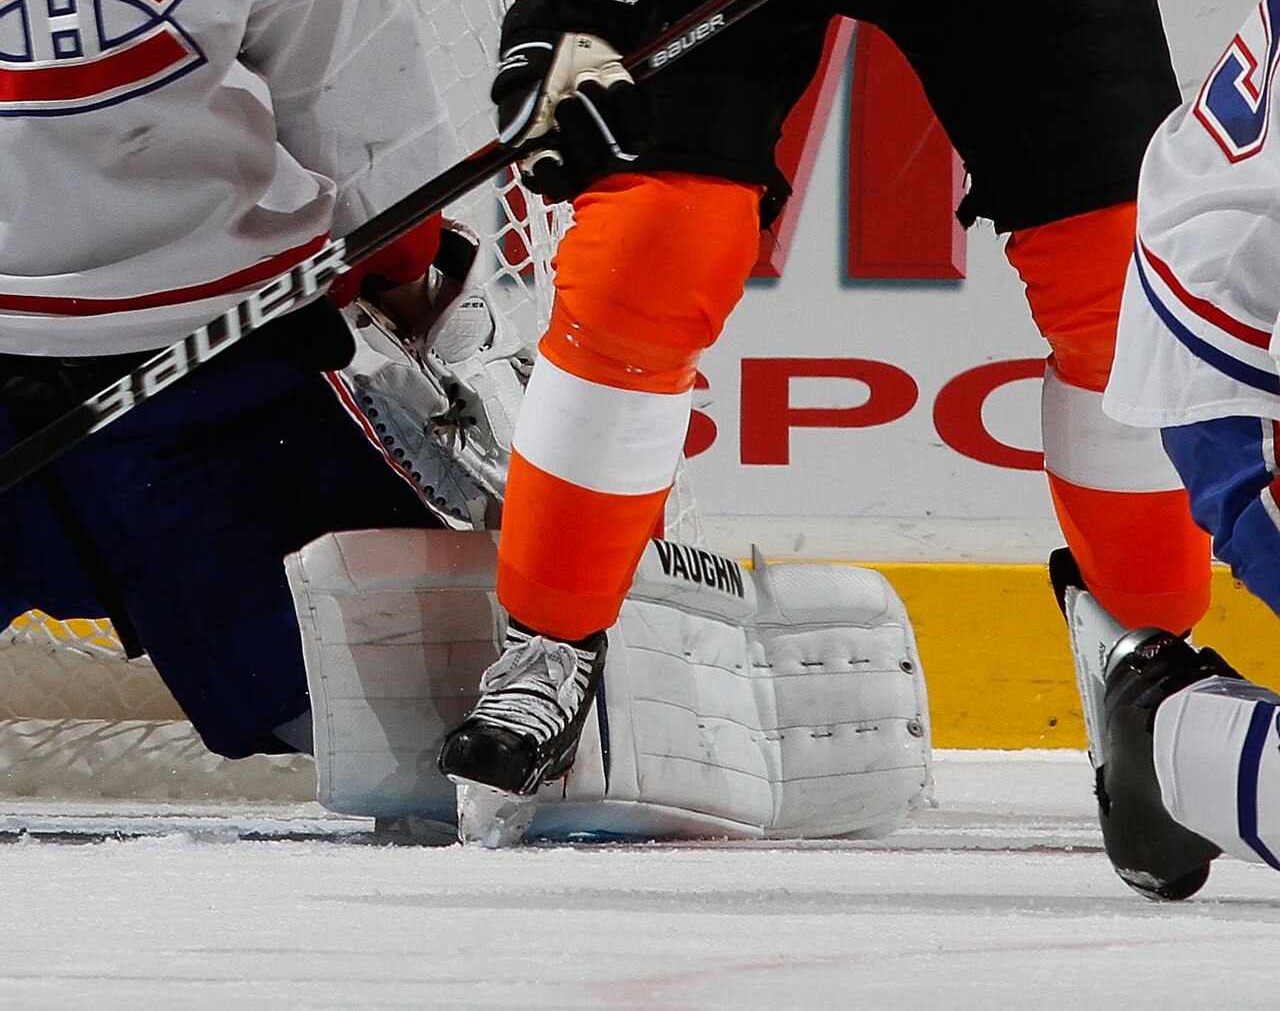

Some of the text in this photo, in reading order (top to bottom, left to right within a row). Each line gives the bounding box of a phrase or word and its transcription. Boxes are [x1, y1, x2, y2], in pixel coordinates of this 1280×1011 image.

[650, 12, 726, 69] BAUER
[82, 236, 352, 434] BAUER
[651, 538, 745, 599] VAUGHN
